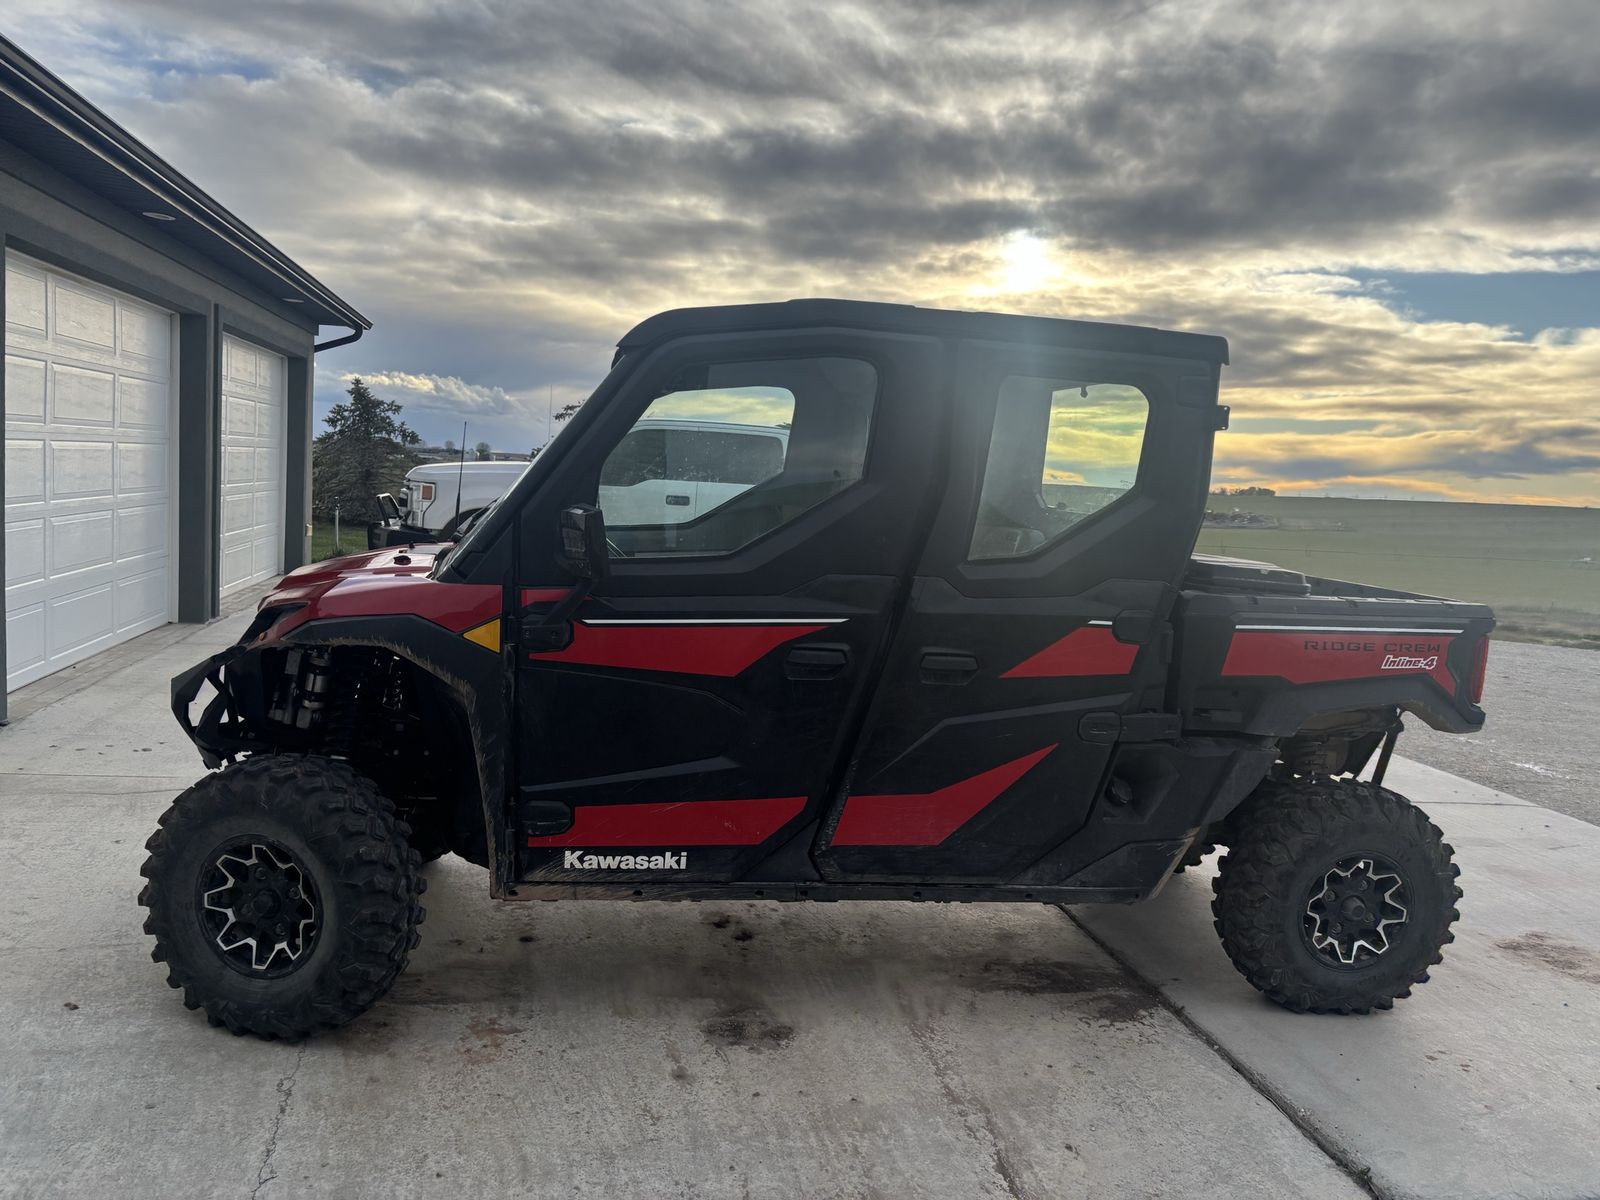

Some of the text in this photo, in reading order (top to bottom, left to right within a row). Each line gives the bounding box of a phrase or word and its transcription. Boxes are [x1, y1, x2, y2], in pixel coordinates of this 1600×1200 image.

[1304, 640, 1441, 653] RIDGE CREW
[564, 850, 687, 870] Kawasaki
